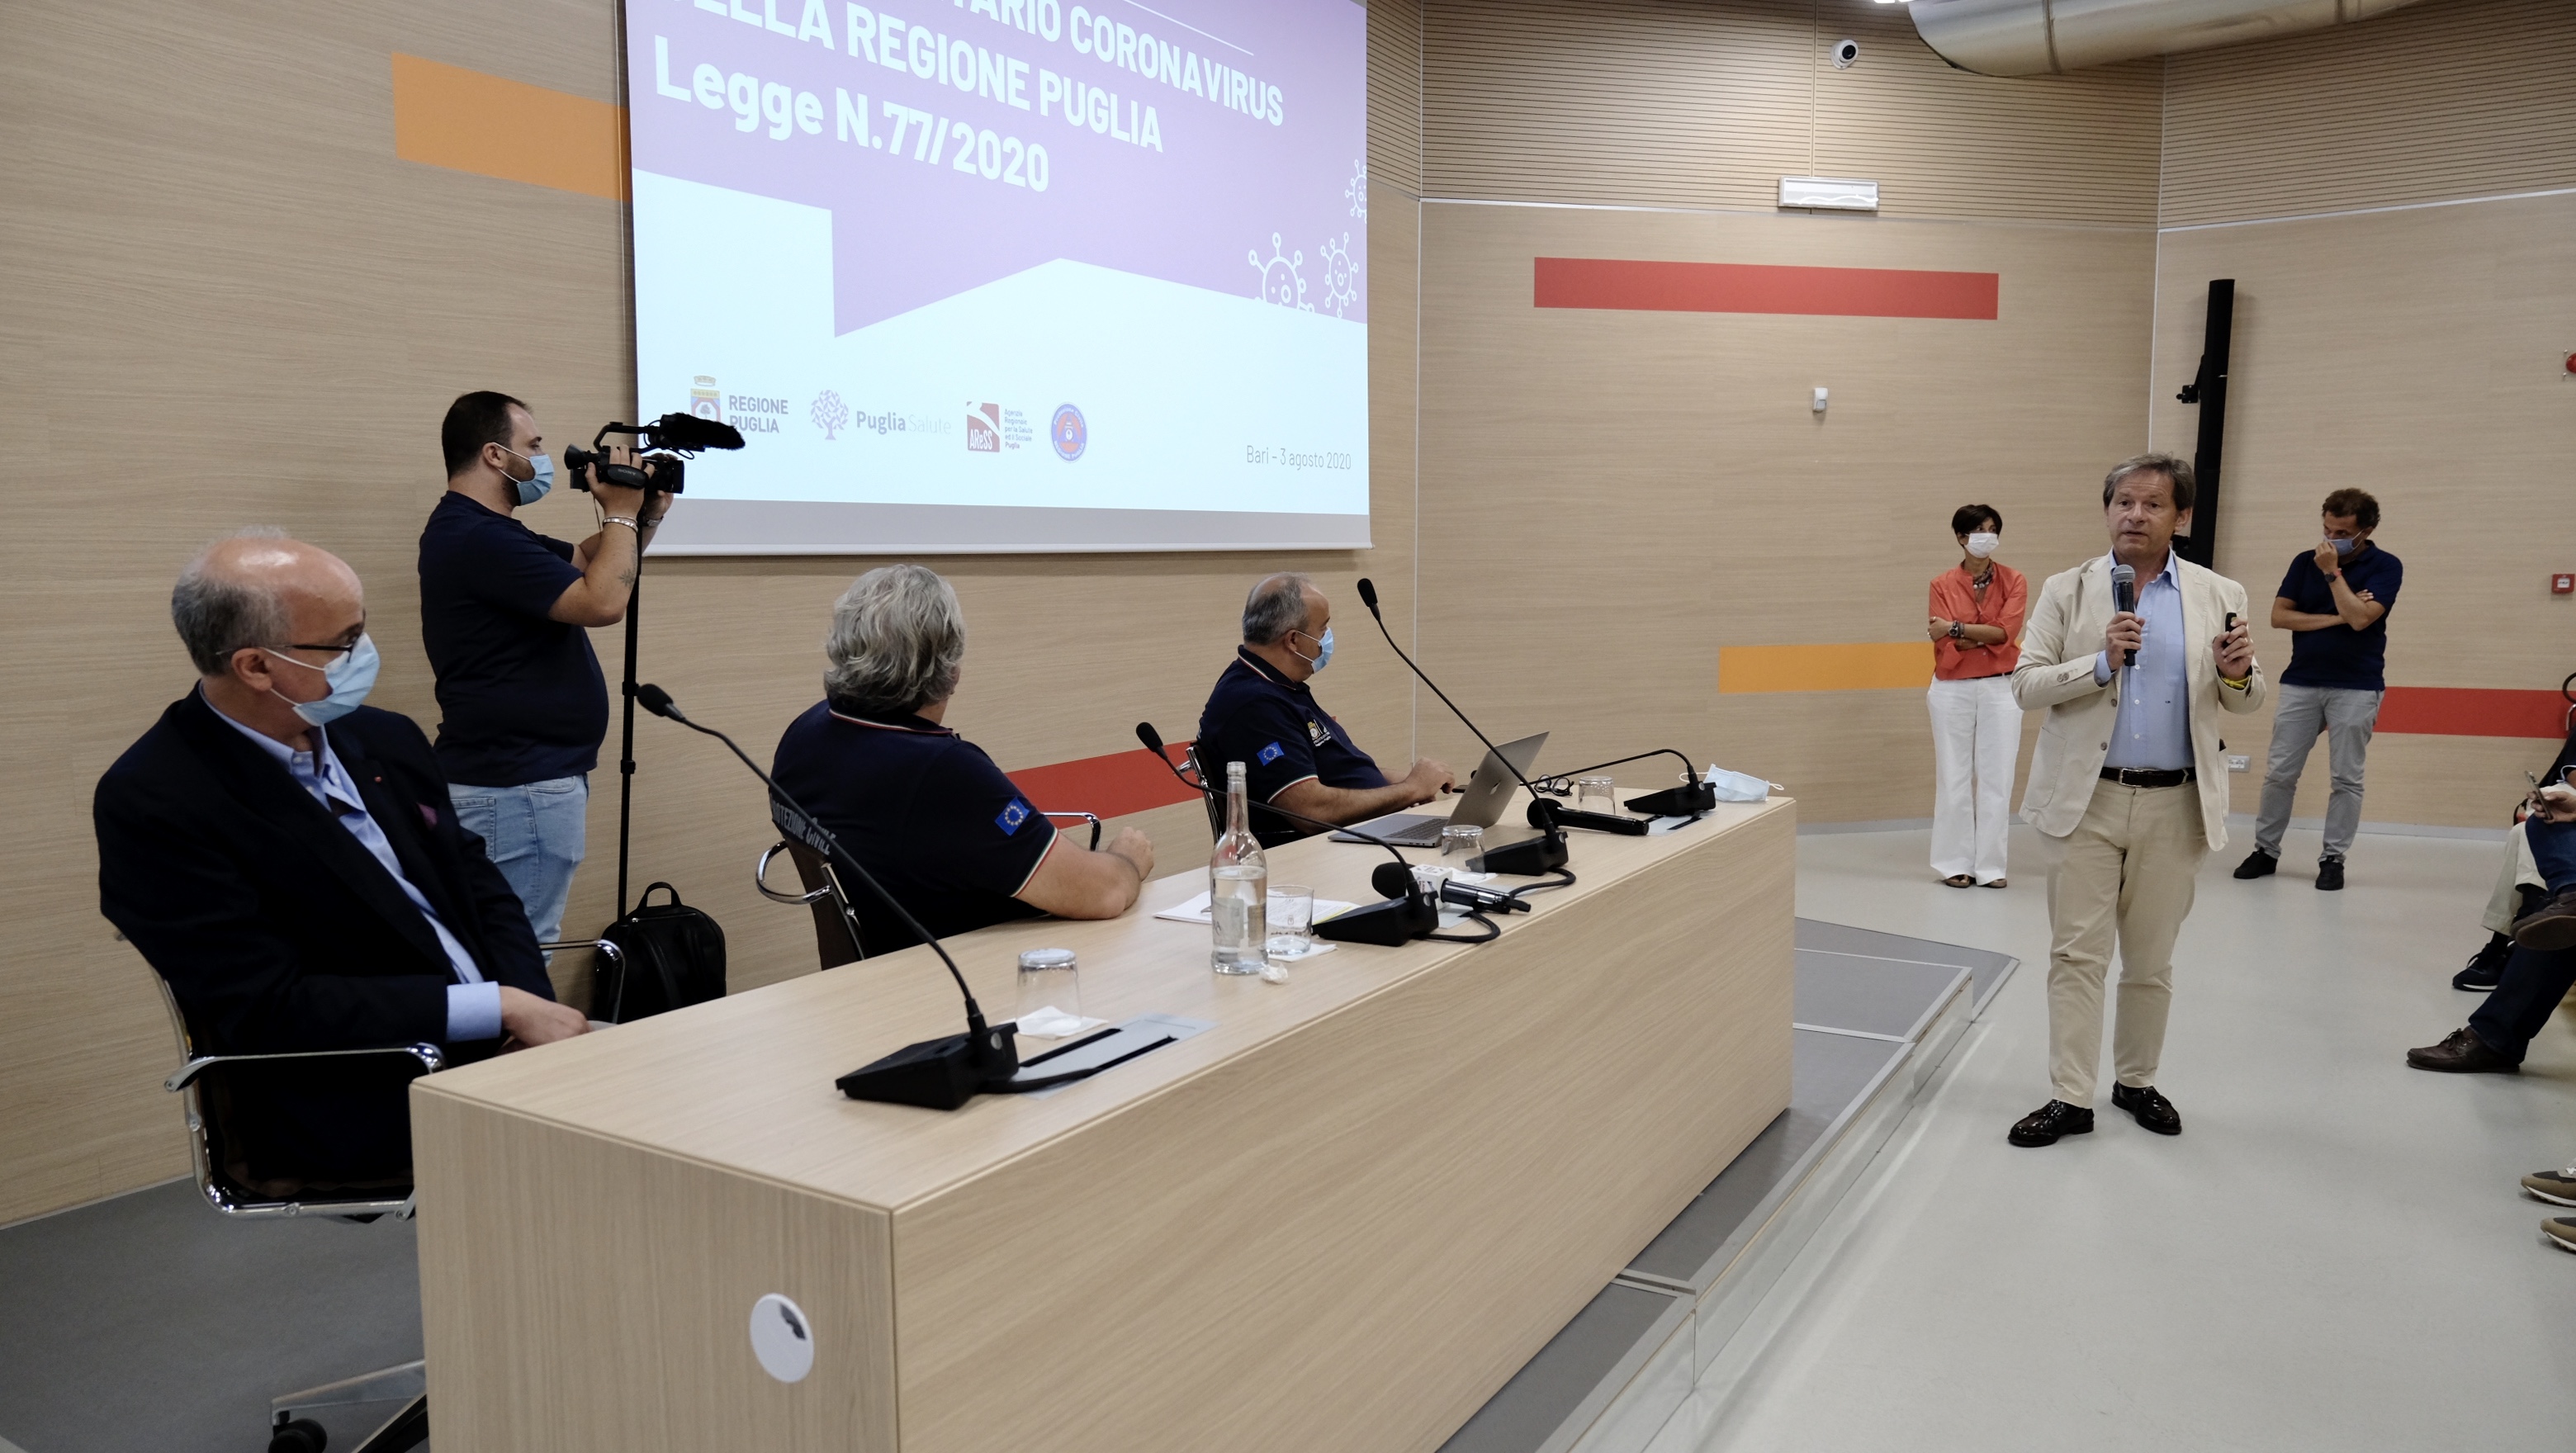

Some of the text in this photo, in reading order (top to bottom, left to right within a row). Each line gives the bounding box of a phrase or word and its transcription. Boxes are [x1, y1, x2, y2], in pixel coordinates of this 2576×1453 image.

[953, 0, 1284, 126] ARIO CORONAVIRUS
[674, 0, 1163, 153] LLA REGIONE PUGLIA
[655, 35, 1049, 192] Legge N.77/2020
[728, 395, 788, 414] REGIONE
[730, 415, 779, 433] PUGLIA
[856, 410, 907, 435] Puglia
[968, 428, 993, 450] AReSS
[1246, 445, 1270, 465] Bari
[1280, 447, 1286, 466] 3
[1289, 452, 1324, 471] agosto
[1327, 452, 1352, 471] 2020
